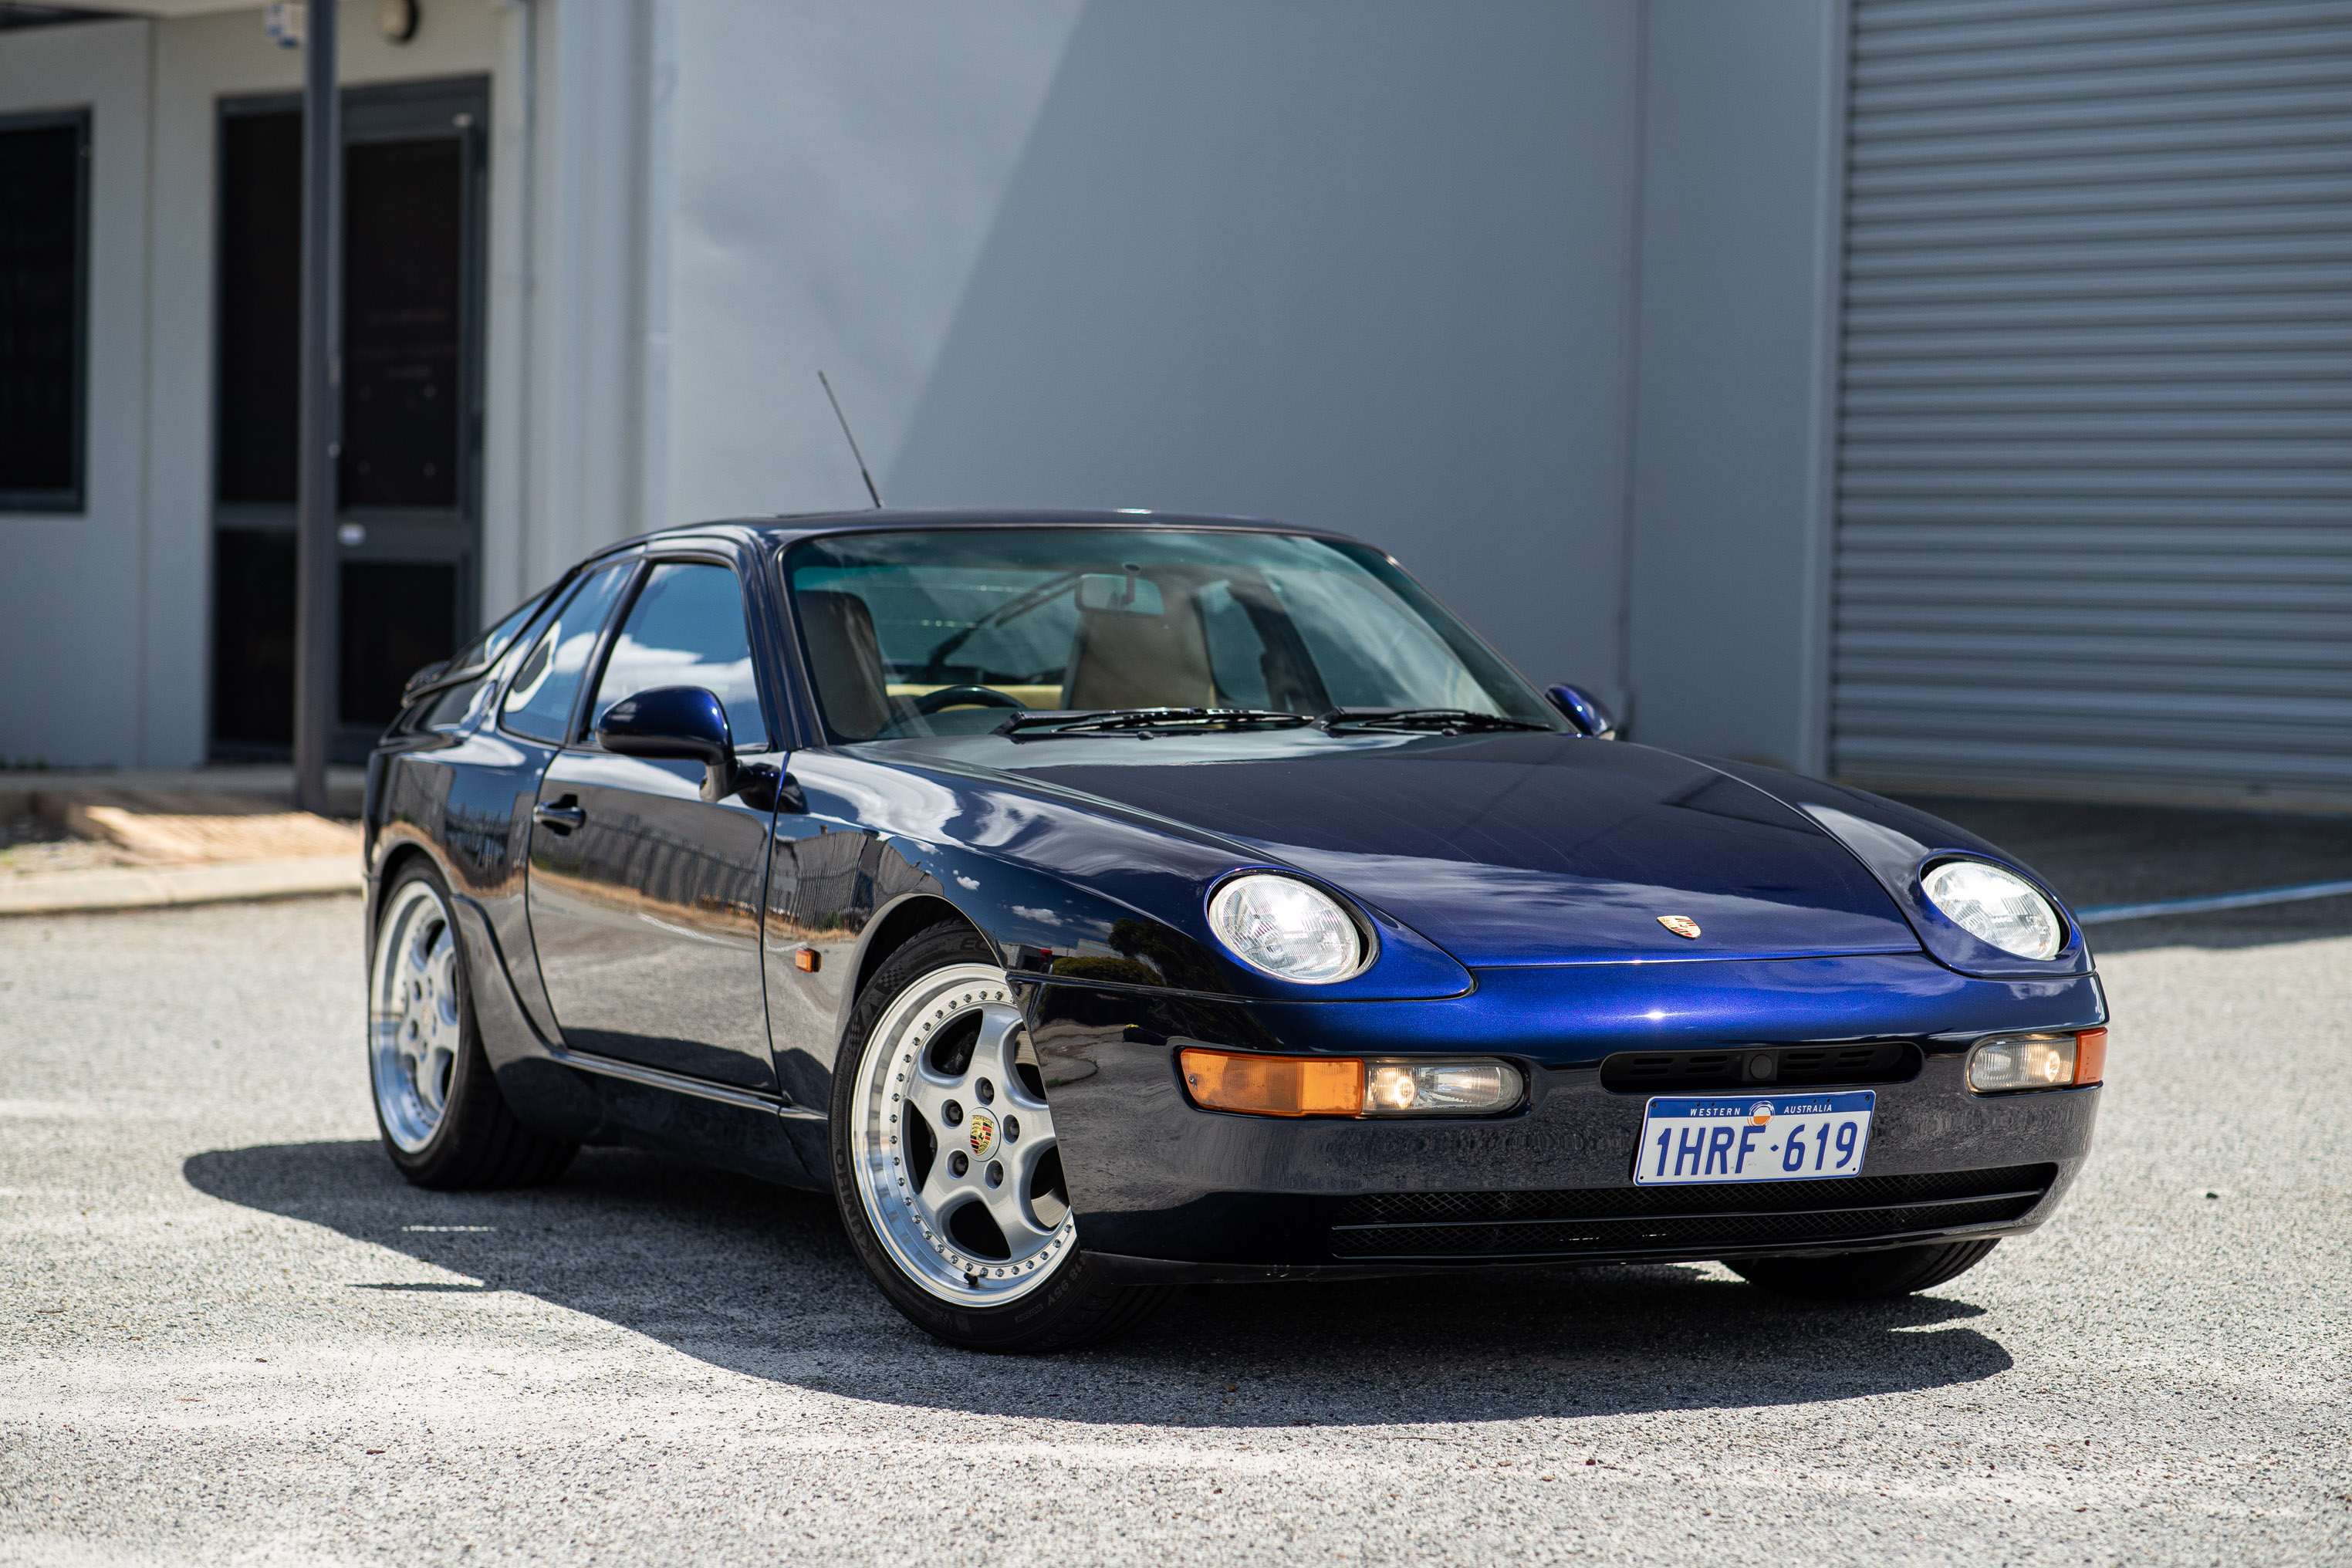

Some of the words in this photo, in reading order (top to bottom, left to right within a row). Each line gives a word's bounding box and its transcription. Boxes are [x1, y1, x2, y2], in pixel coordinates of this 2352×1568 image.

[1690, 1107, 1741, 1117] WESTERN
[1784, 1103, 1833, 1114] AUSTRALIA
[835, 1148, 875, 1258] KUMHO
[1046, 1279, 1070, 1306] 95Y
